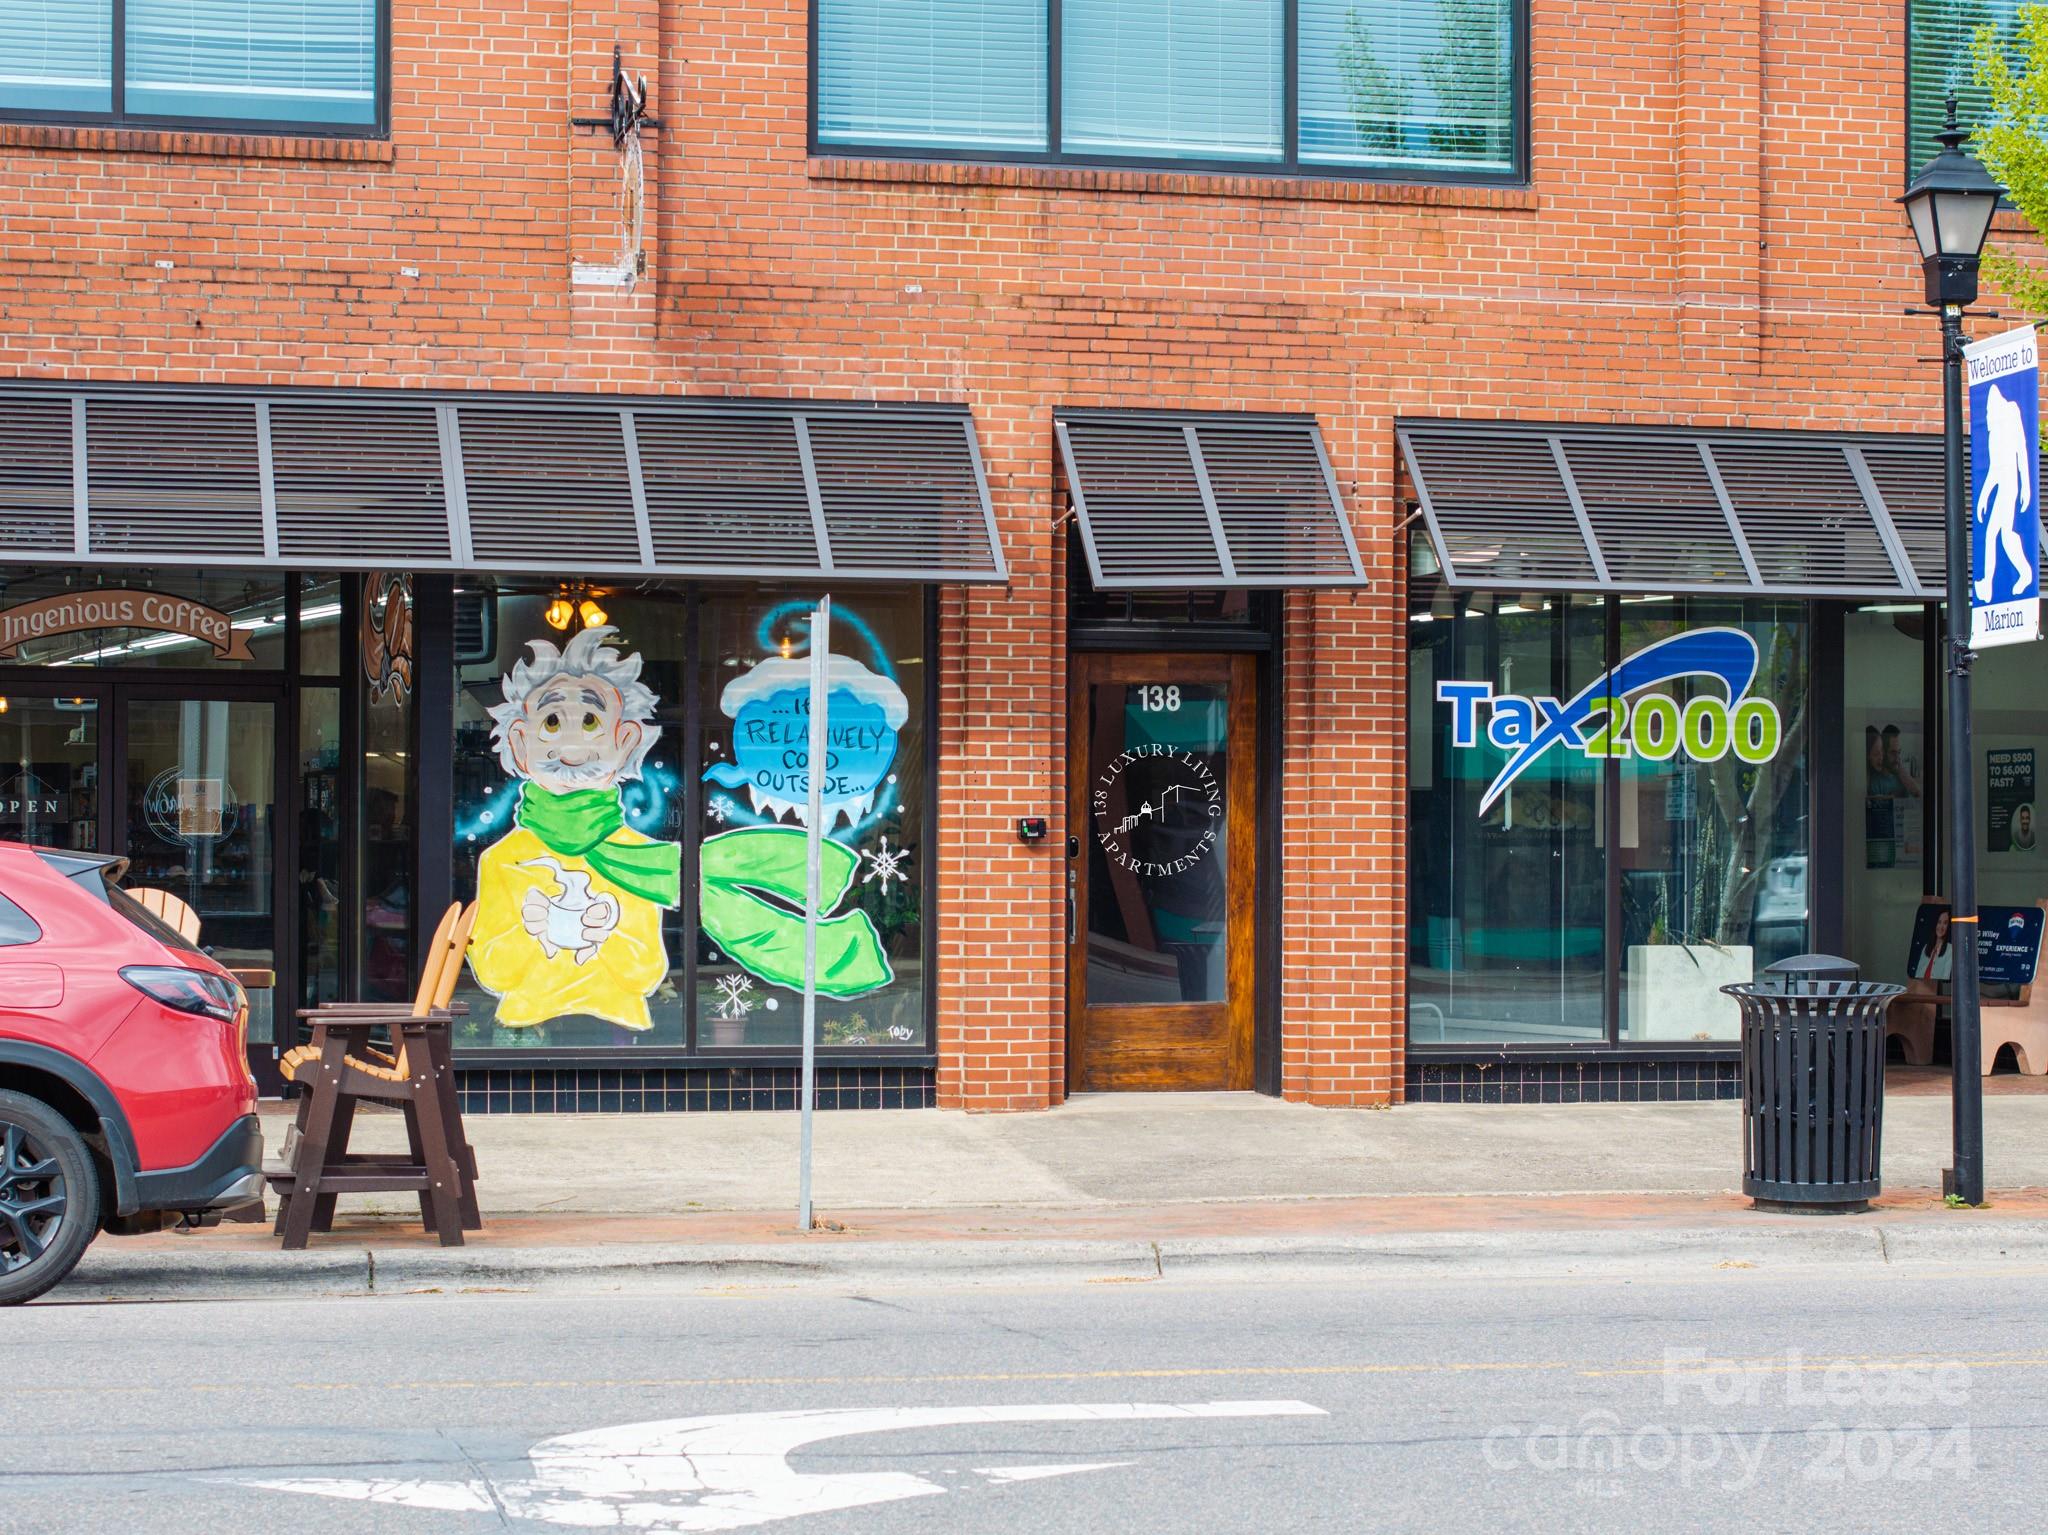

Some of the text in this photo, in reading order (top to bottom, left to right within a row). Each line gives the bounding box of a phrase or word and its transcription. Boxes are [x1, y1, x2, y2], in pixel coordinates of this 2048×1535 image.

[1969, 344, 2033, 380] Welcome to
[3, 597, 229, 643] Ingenious Coffee
[1984, 608, 2024, 632] Marion
[1138, 685, 1181, 712] 138
[745, 719, 886, 754] RELAIVELY
[782, 750, 839, 771] COD
[1989, 752, 2033, 764] NEED $500
[757, 770, 865, 795] OUTSDE...
[1094, 743, 1221, 817] 138 LUXURY LIVING
[1989, 778, 2014, 788] FAST?
[1990, 766, 2001, 776] TO
[0, 801, 58, 813] PEN
[1097, 829, 1217, 876] APARTMENTS
[1995, 944, 2029, 953] EXPERIENCE
